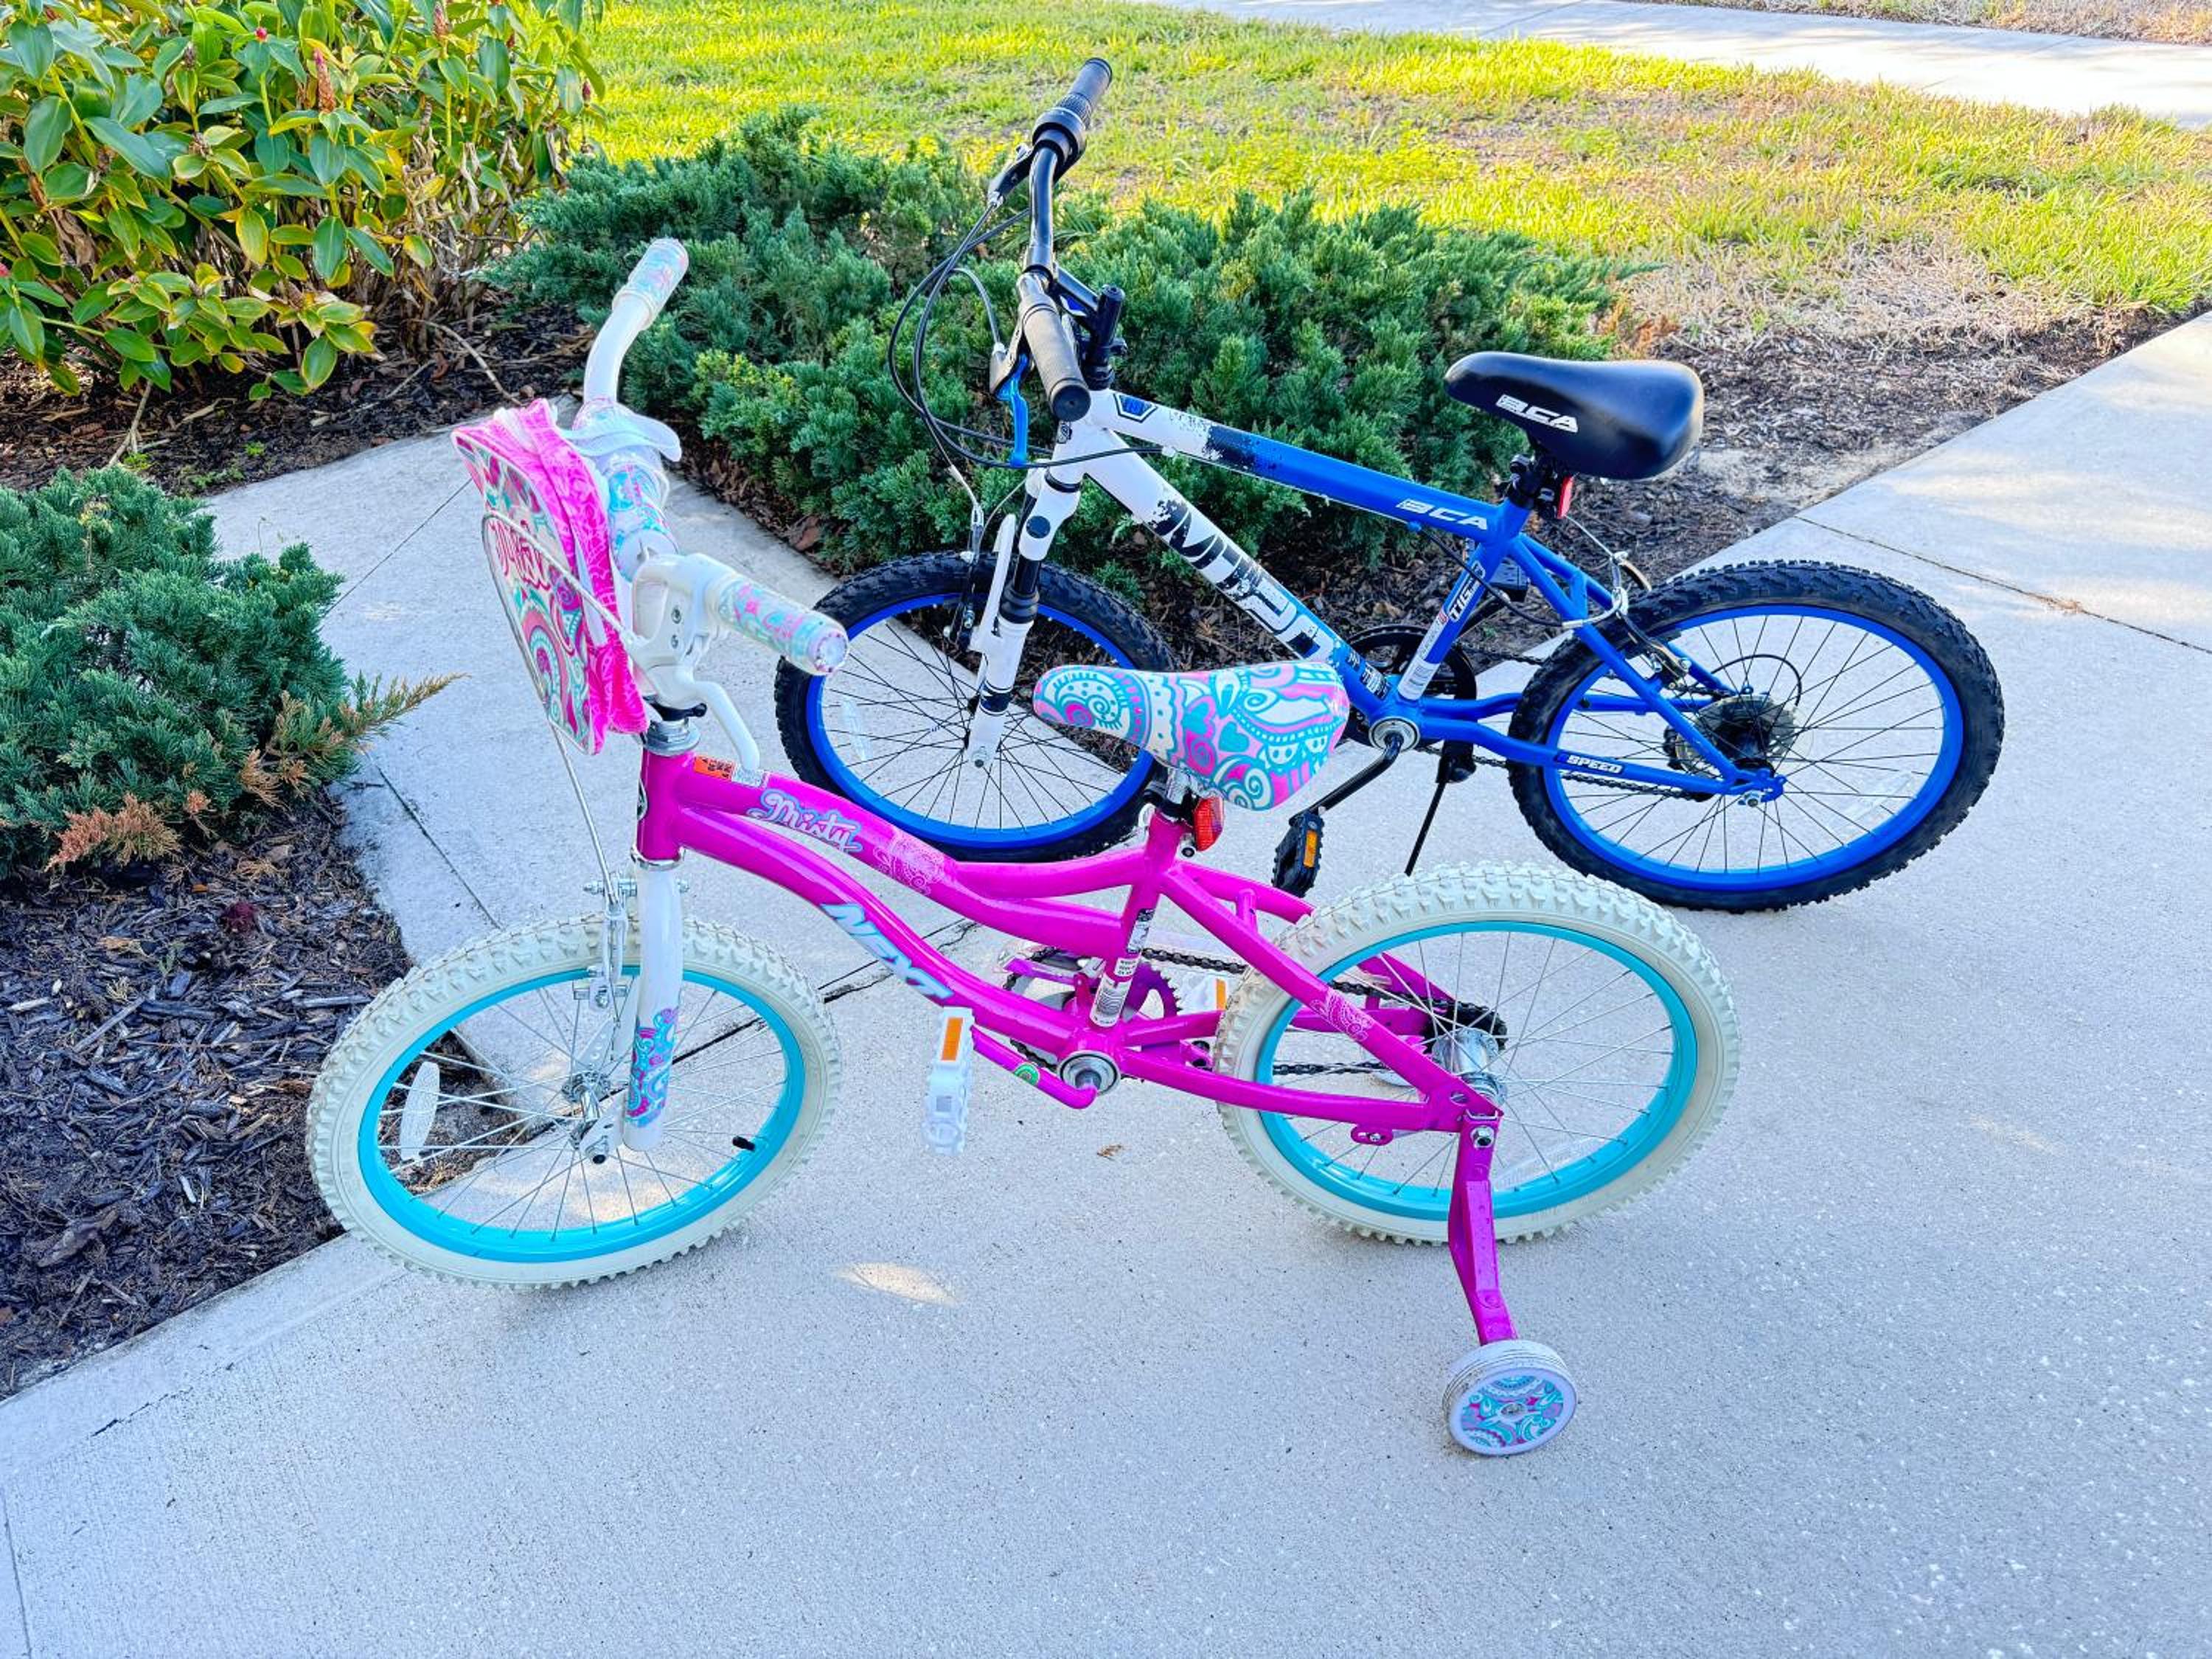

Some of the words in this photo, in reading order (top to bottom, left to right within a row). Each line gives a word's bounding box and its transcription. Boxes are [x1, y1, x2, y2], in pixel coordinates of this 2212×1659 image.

[1567, 754, 1623, 773] SPEED
[746, 788, 863, 852] Misty
[818, 902, 954, 998] NEXT
